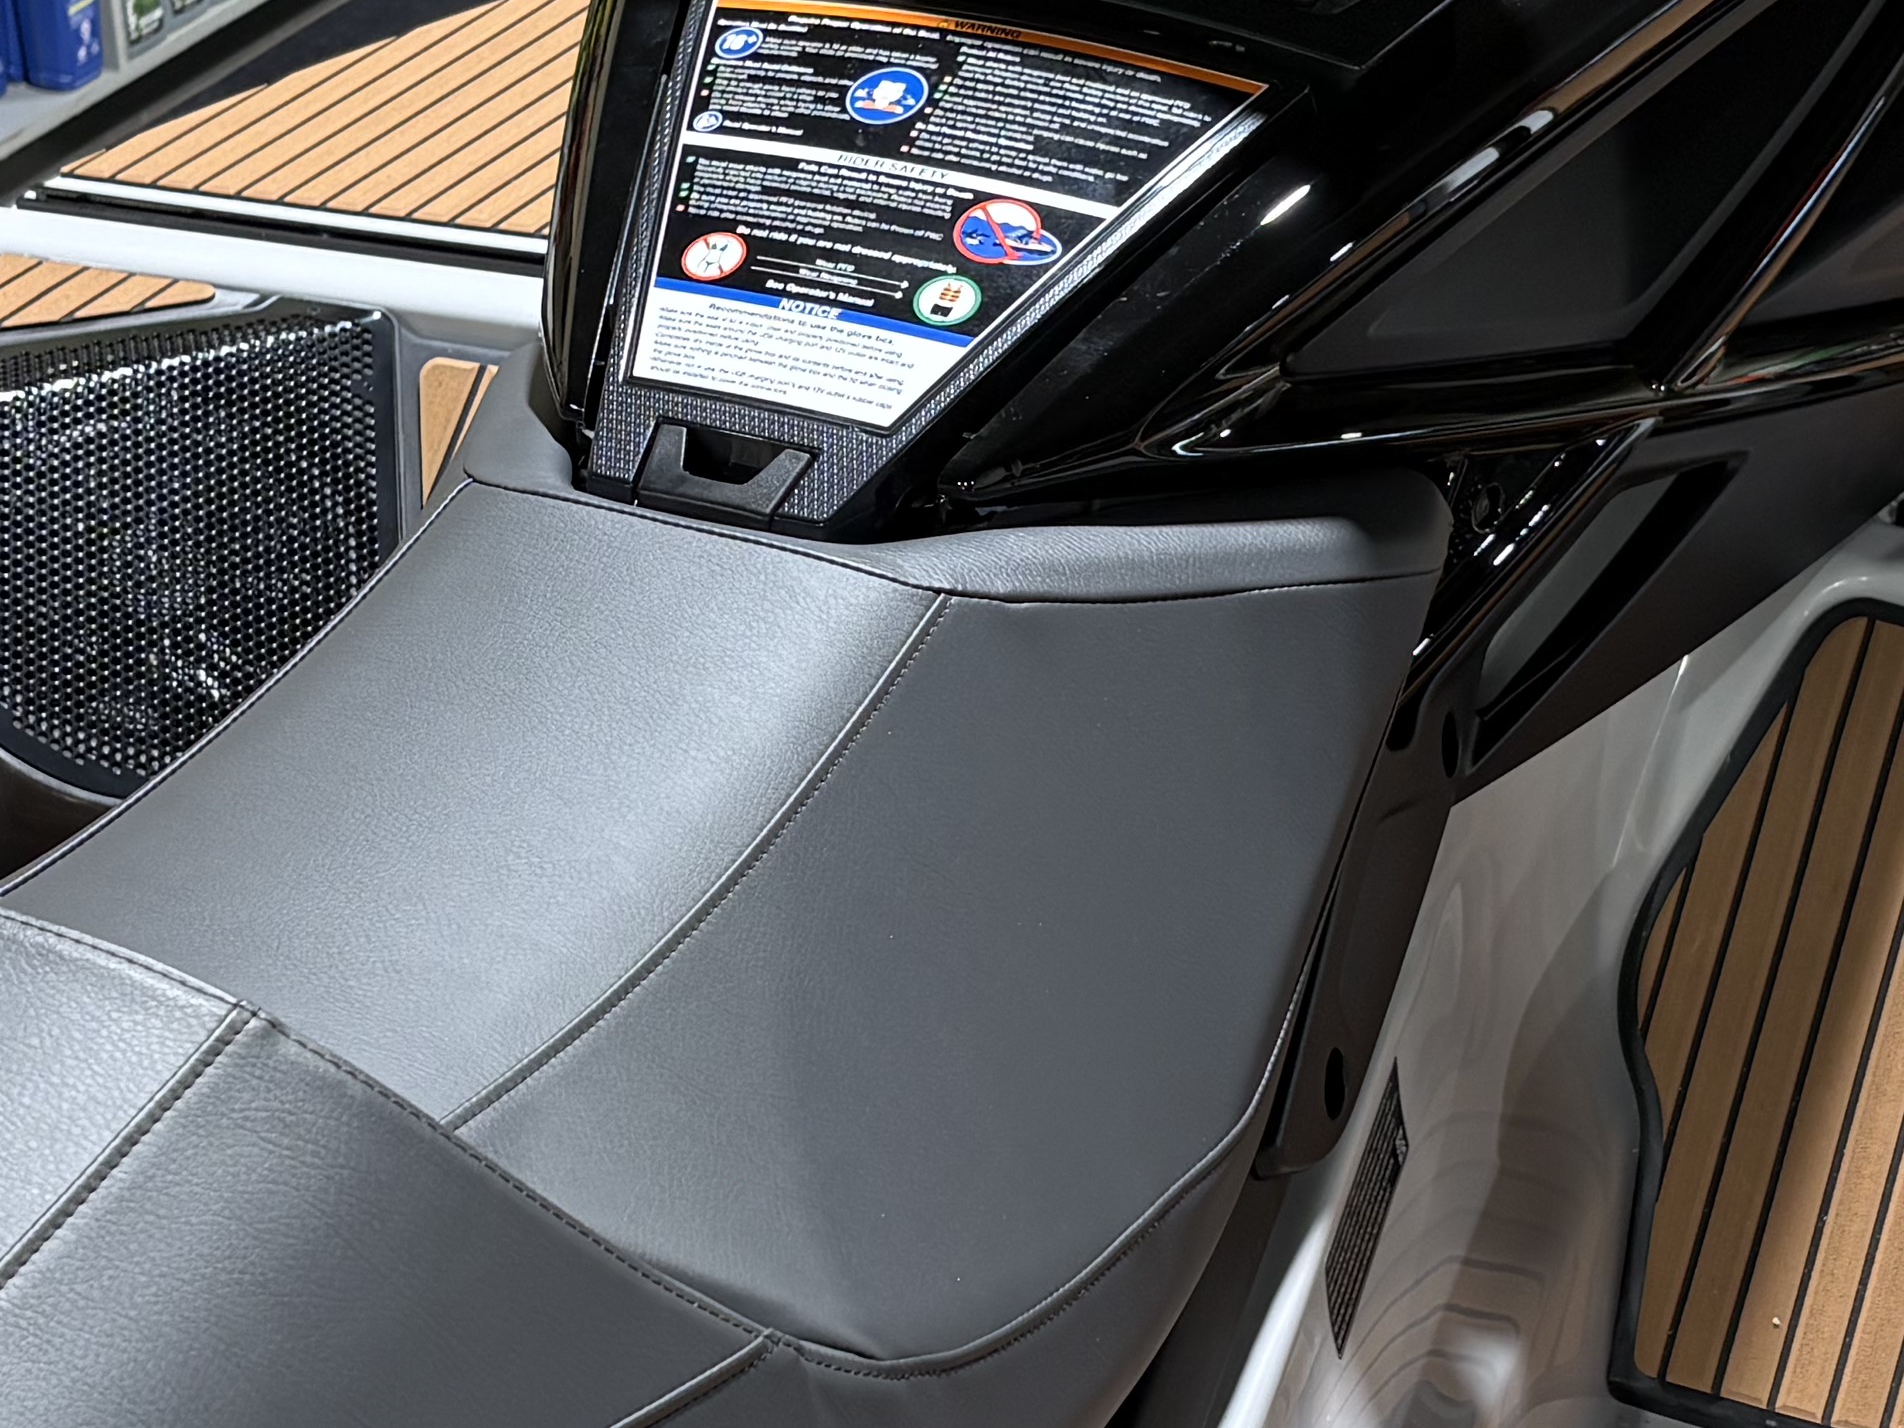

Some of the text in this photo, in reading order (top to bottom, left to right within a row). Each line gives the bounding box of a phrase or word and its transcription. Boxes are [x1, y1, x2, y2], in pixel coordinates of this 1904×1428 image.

[953, 20, 1023, 40] WARNING
[836, 153, 950, 182] RIDER SAFETY
[777, 297, 842, 320] NOTICE
